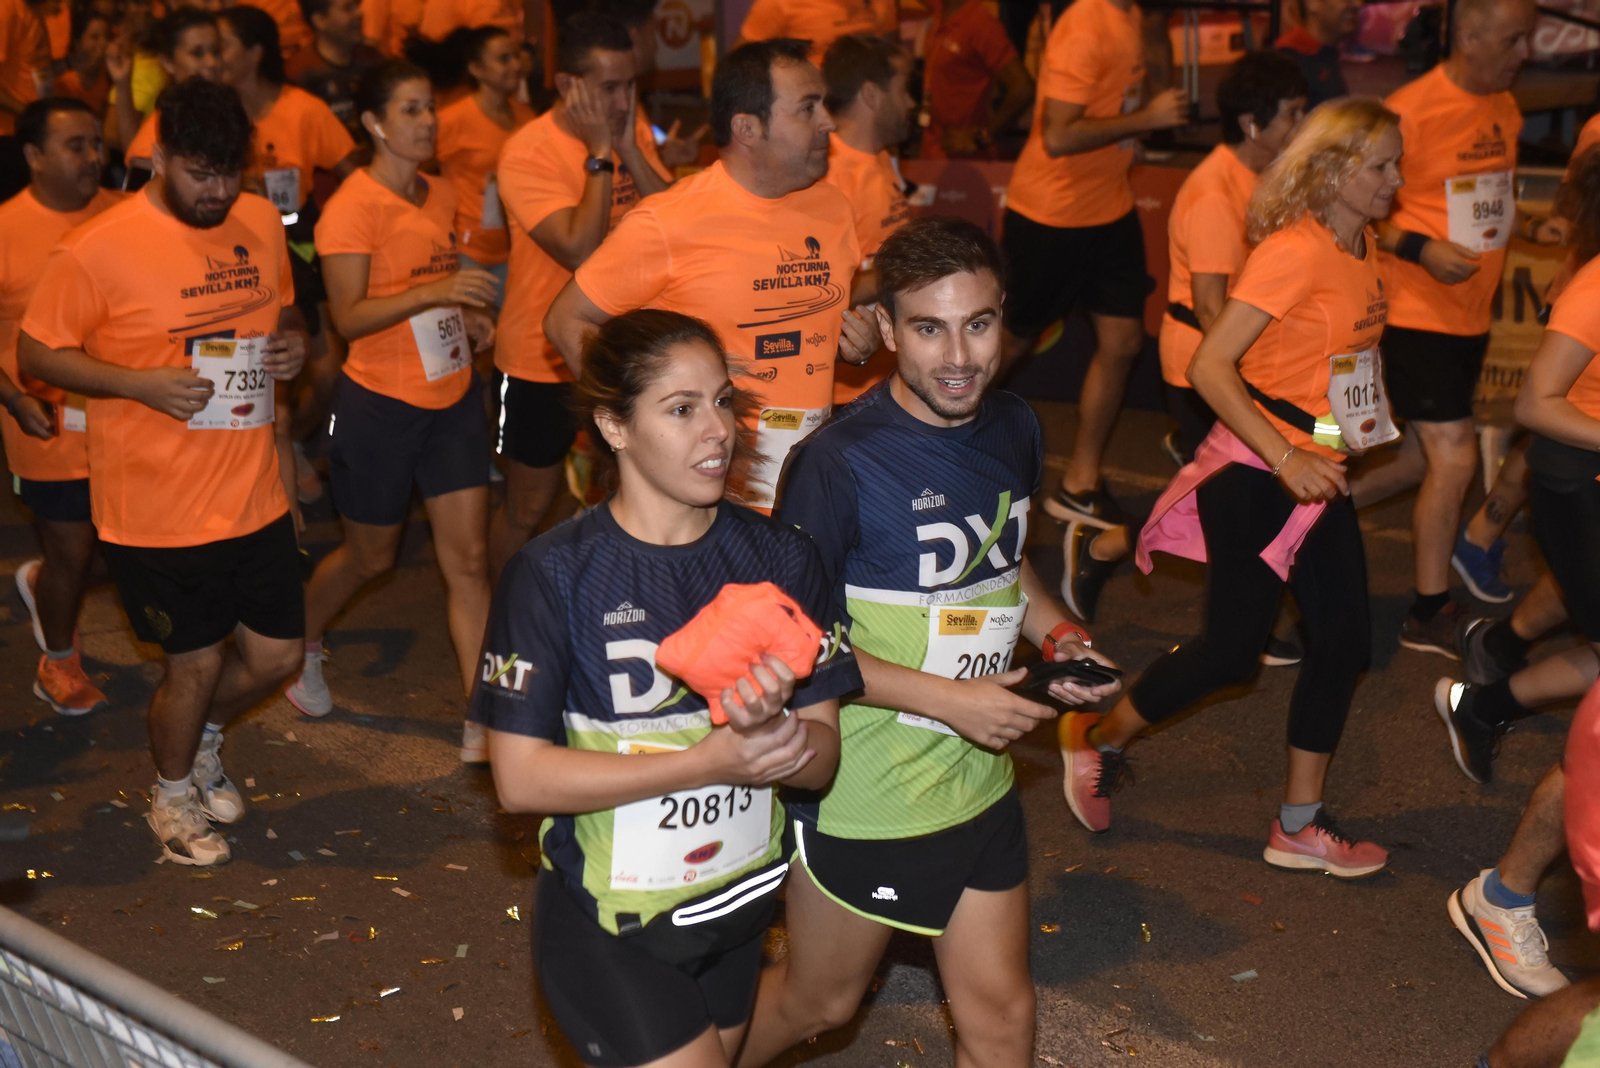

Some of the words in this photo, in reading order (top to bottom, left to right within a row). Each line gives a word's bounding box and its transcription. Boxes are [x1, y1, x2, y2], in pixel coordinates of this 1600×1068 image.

[205, 266, 260, 282] NOCTURNA
[776, 261, 831, 275] NOCTURNA
[180, 282, 233, 299] SEVILLA
[752, 276, 803, 292] SEVILLA
[224, 368, 266, 391] 7332
[911, 494, 946, 511] HORIZON
[916, 490, 1031, 588] DXT
[603, 609, 646, 626] HORIZON
[482, 652, 533, 691] DXT
[658, 784, 752, 830] 20813
